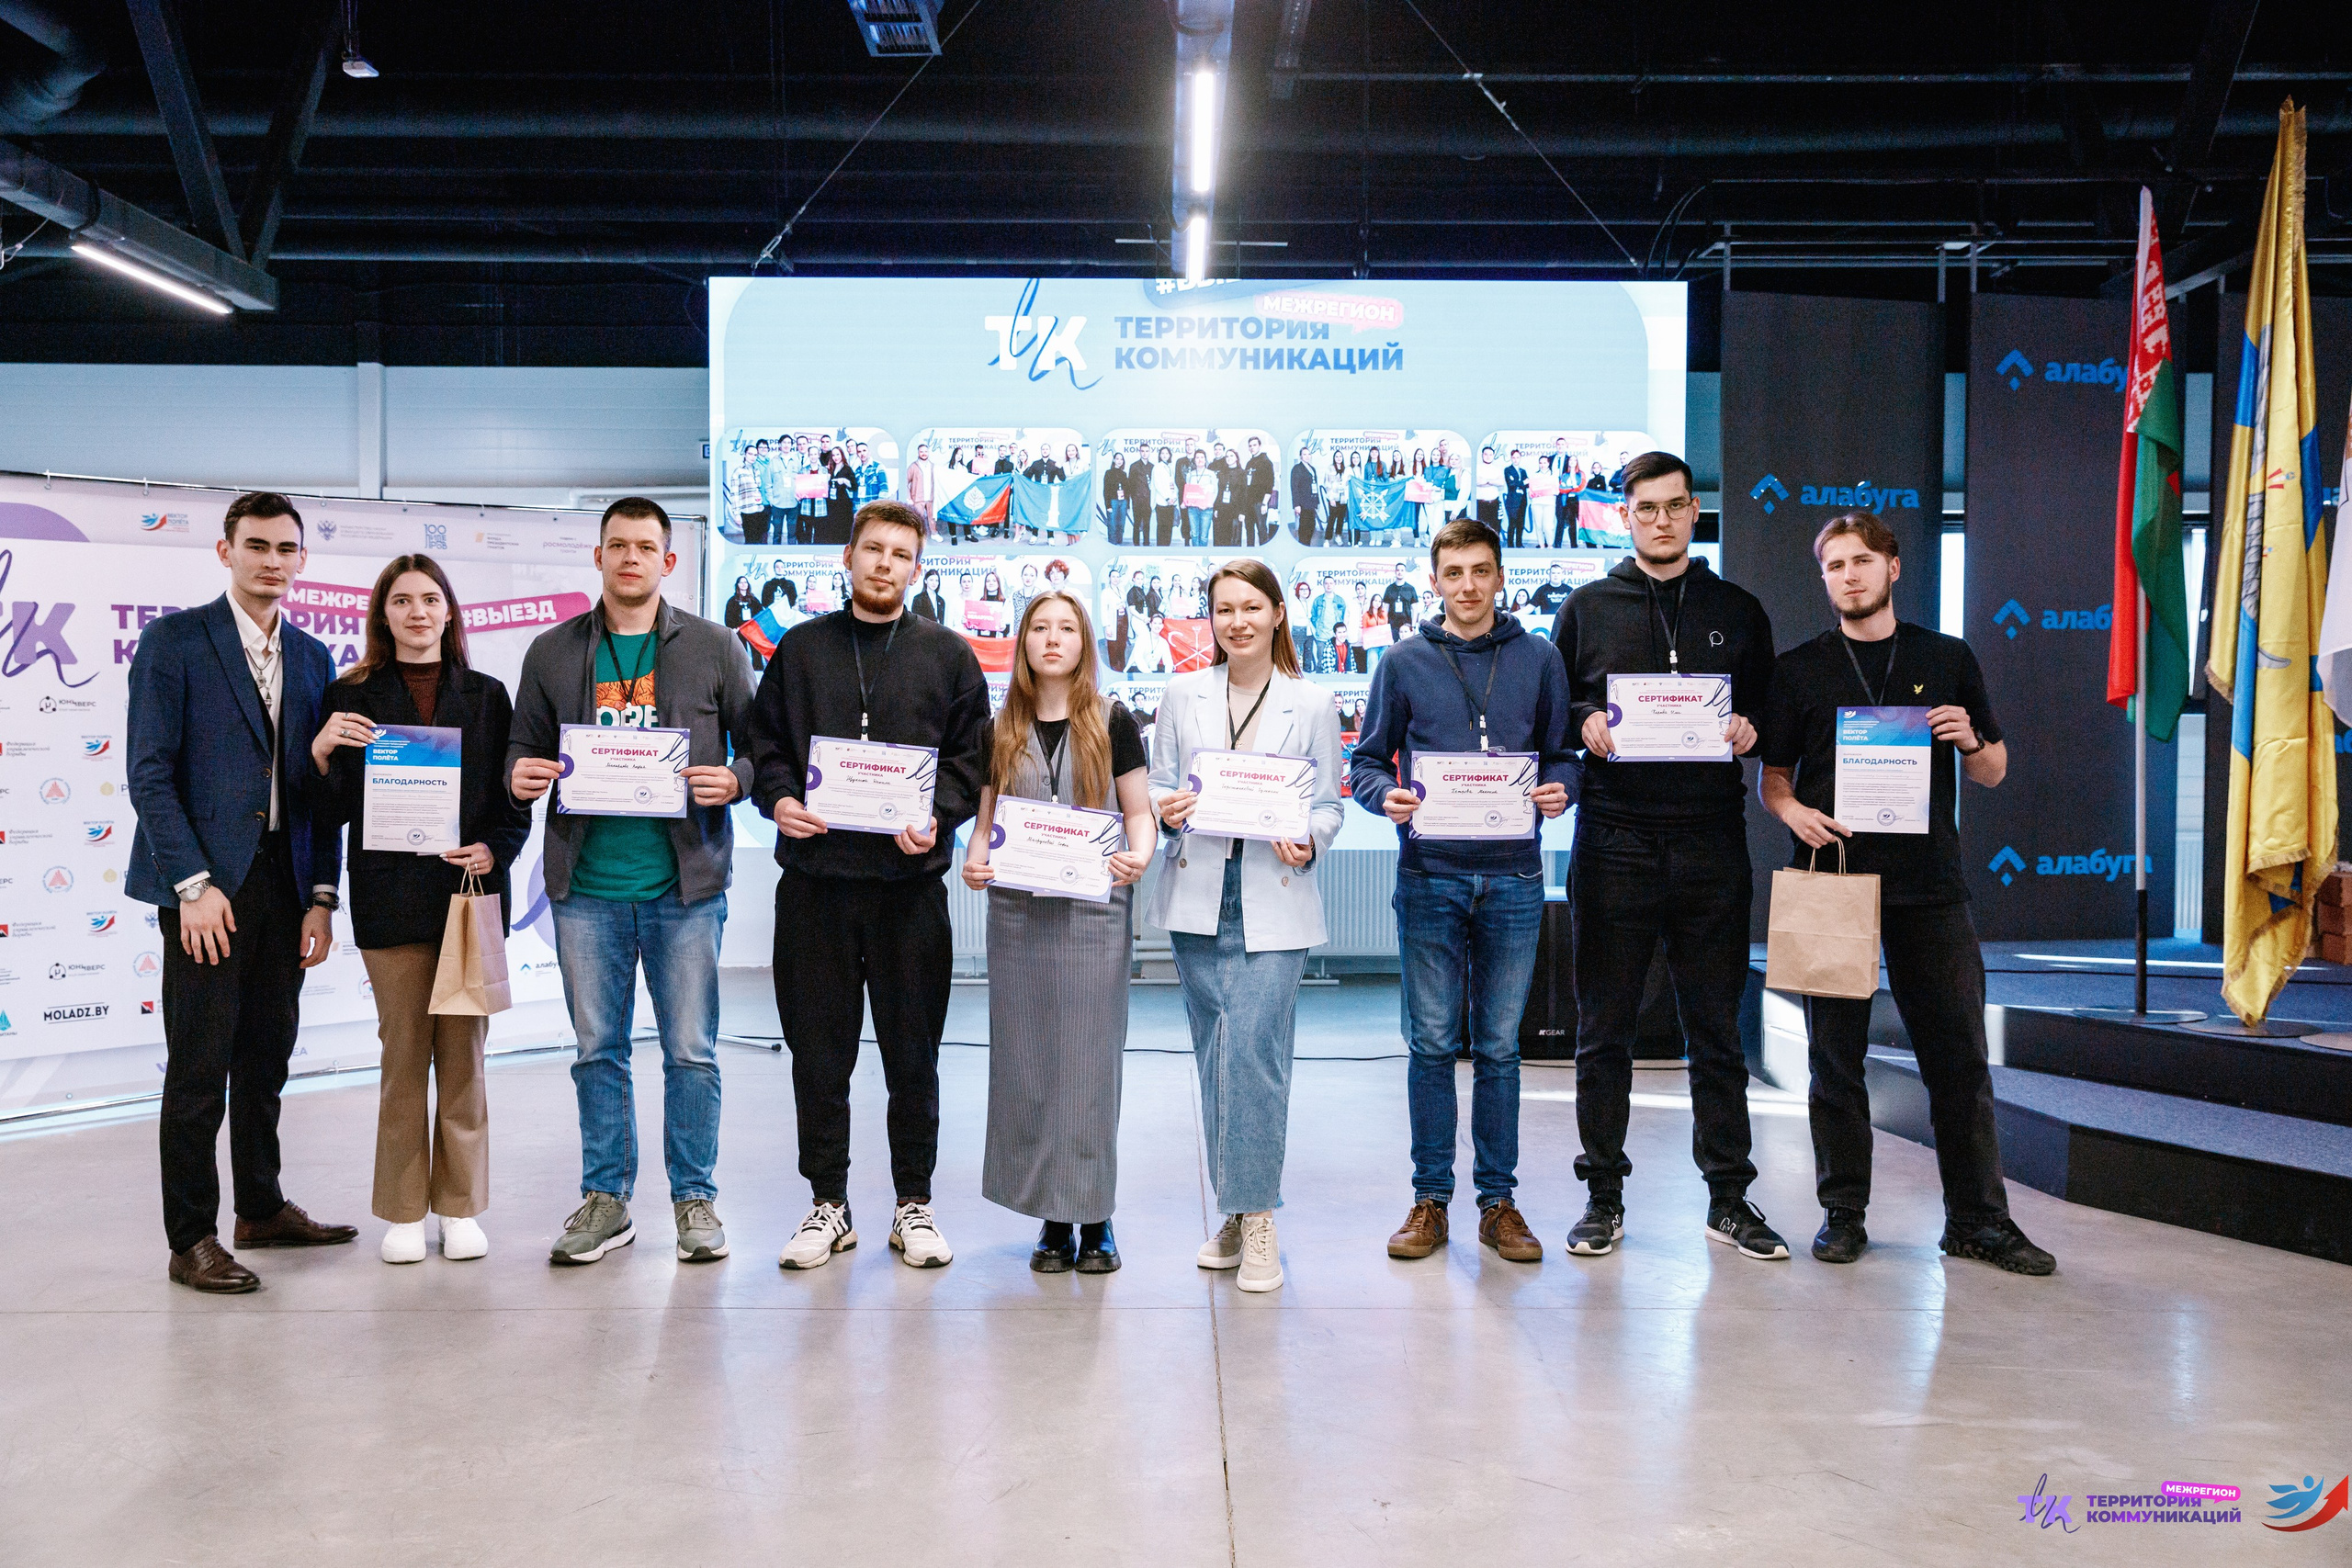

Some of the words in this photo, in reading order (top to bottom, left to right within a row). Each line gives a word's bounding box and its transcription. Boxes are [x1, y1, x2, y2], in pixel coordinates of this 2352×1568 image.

[1262, 295, 1396, 321] МЕЖРЕГИОН
[1114, 316, 1329, 340] ТЕРРИТОРИЯ
[1114, 342, 1404, 375] КОММУНИКАЦИЙ
[2044, 358, 2129, 393] алабу
[1800, 480, 1919, 515] алабуга
[921, 558, 971, 566] РИТОРИЯ
[287, 588, 369, 610] МЕЖРЕ
[2041, 603, 2112, 631] алаб
[1638, 694, 1703, 703] СЕРТИФИКАТ
[591, 747, 660, 757] СЕРТИФИКАТ
[840, 761, 907, 774] СЕРТИФИКАТ
[1842, 758, 1917, 766] БЛАГОДАРНОСТЬ
[372, 778, 447, 786] БЛАГОДАРНОСТЬ
[1219, 770, 1286, 783] СЕРТИФИКАТ
[1023, 821, 1091, 838] СЕРТИФИКАТ
[43, 1006, 109, 1021] MOLADZ.BY
